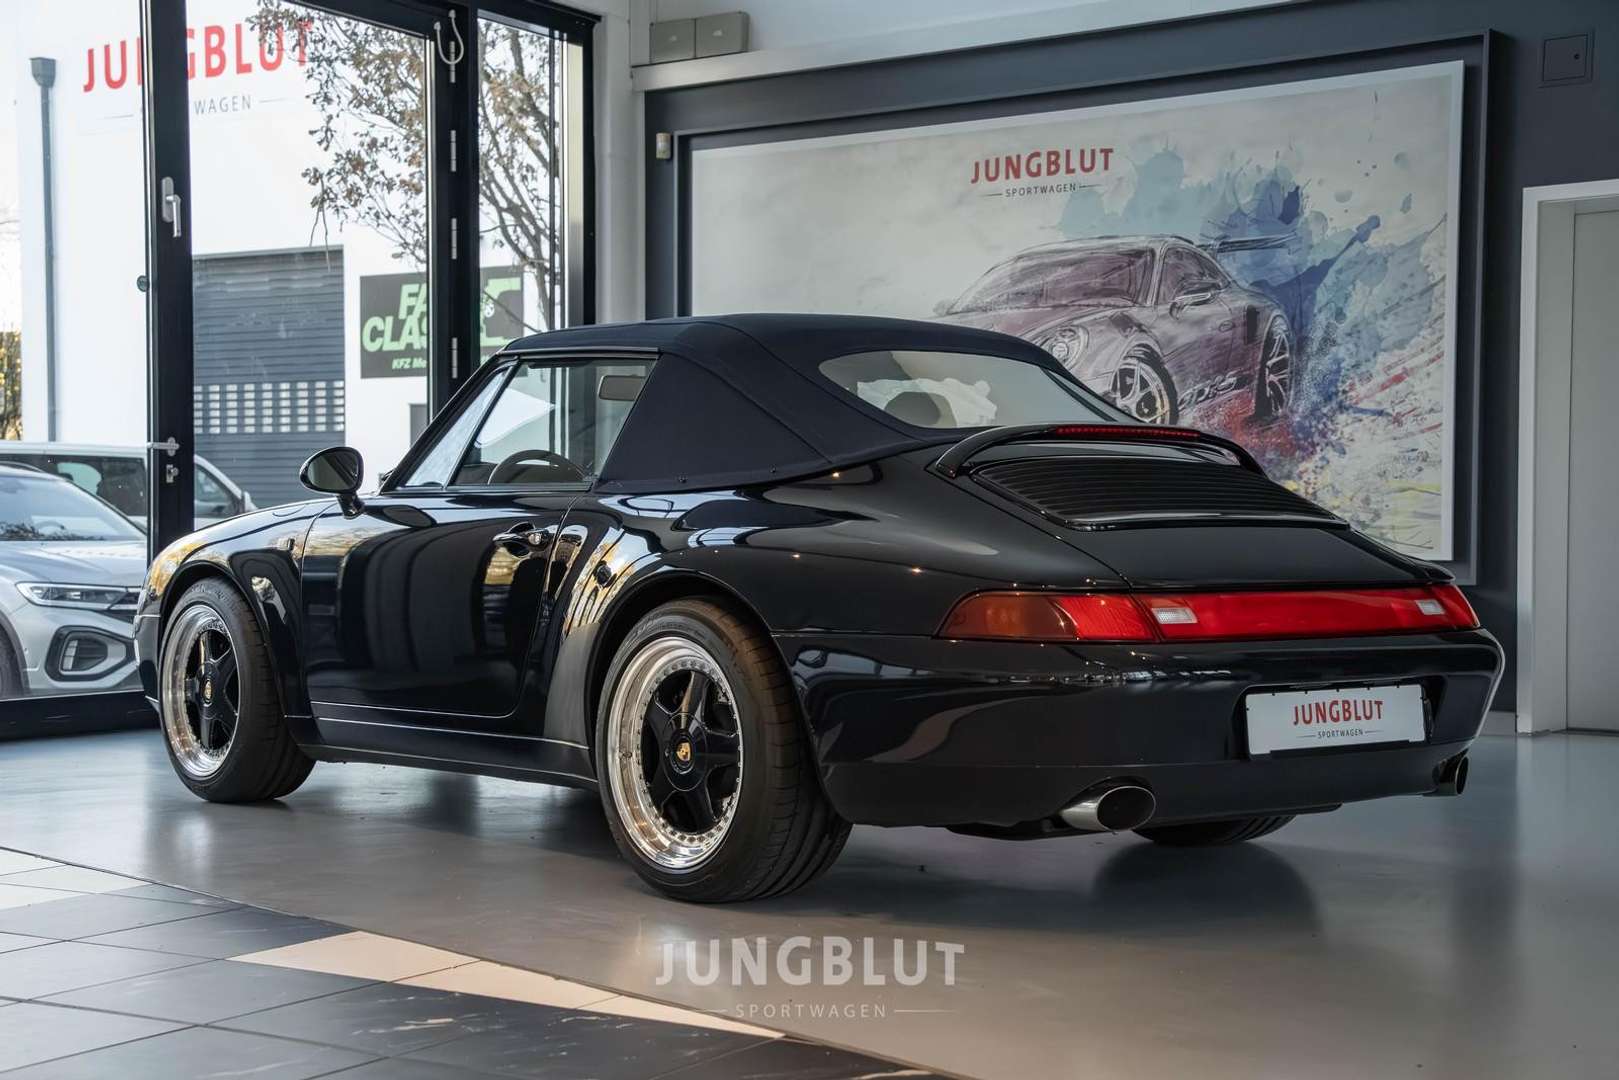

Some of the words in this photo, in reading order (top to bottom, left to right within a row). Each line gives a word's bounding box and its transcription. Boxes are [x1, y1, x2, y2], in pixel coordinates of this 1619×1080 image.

[83, 20, 312, 93] JUBLUT
[193, 94, 252, 115] WAGEN
[970, 148, 1114, 184] JUNGBLUT
[1005, 183, 1077, 197] SPORTWAGEN
[399, 282, 427, 320] FA
[391, 357, 411, 370] KFZ
[1293, 700, 1383, 725] JUNGBLUT
[1317, 729, 1364, 739] SPORTWAGEN
